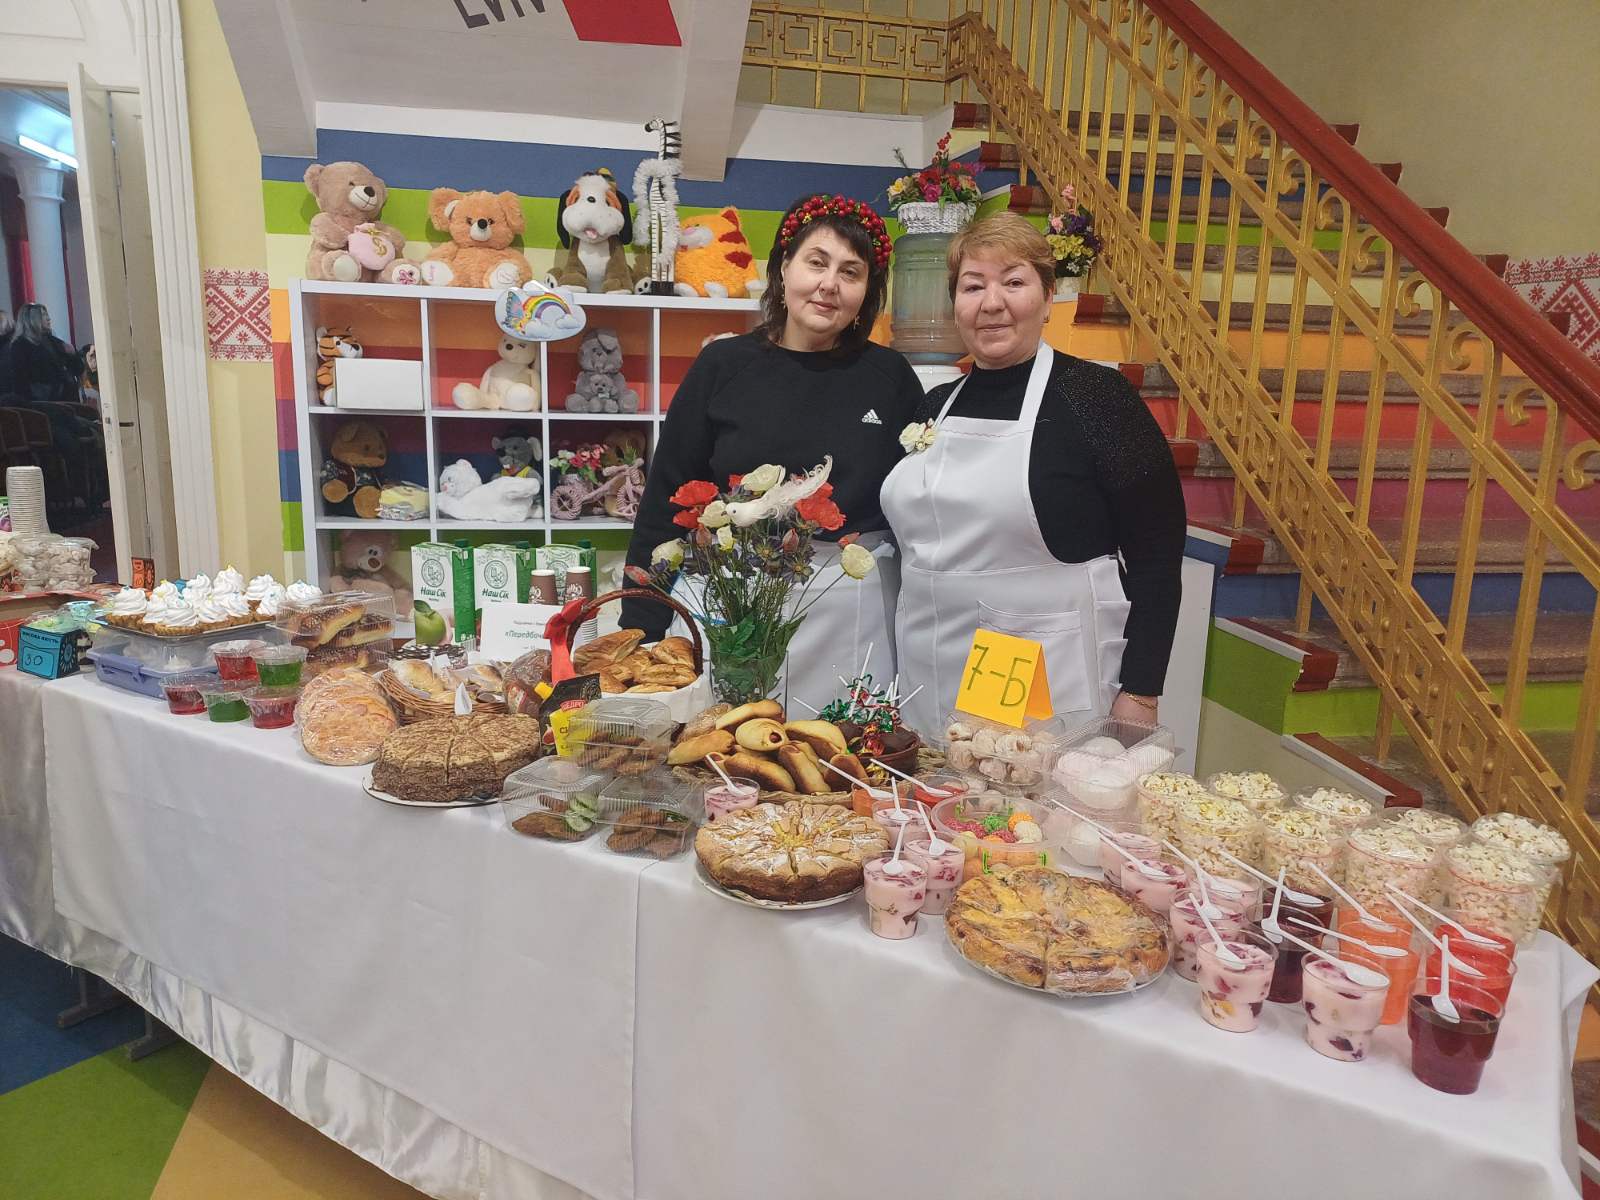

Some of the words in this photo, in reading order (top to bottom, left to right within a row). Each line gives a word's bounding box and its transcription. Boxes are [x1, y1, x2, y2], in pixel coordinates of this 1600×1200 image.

[420, 586, 436, 596] Наш
[482, 588, 499, 597] Наш
[967, 644, 1032, 707] 7-Б
